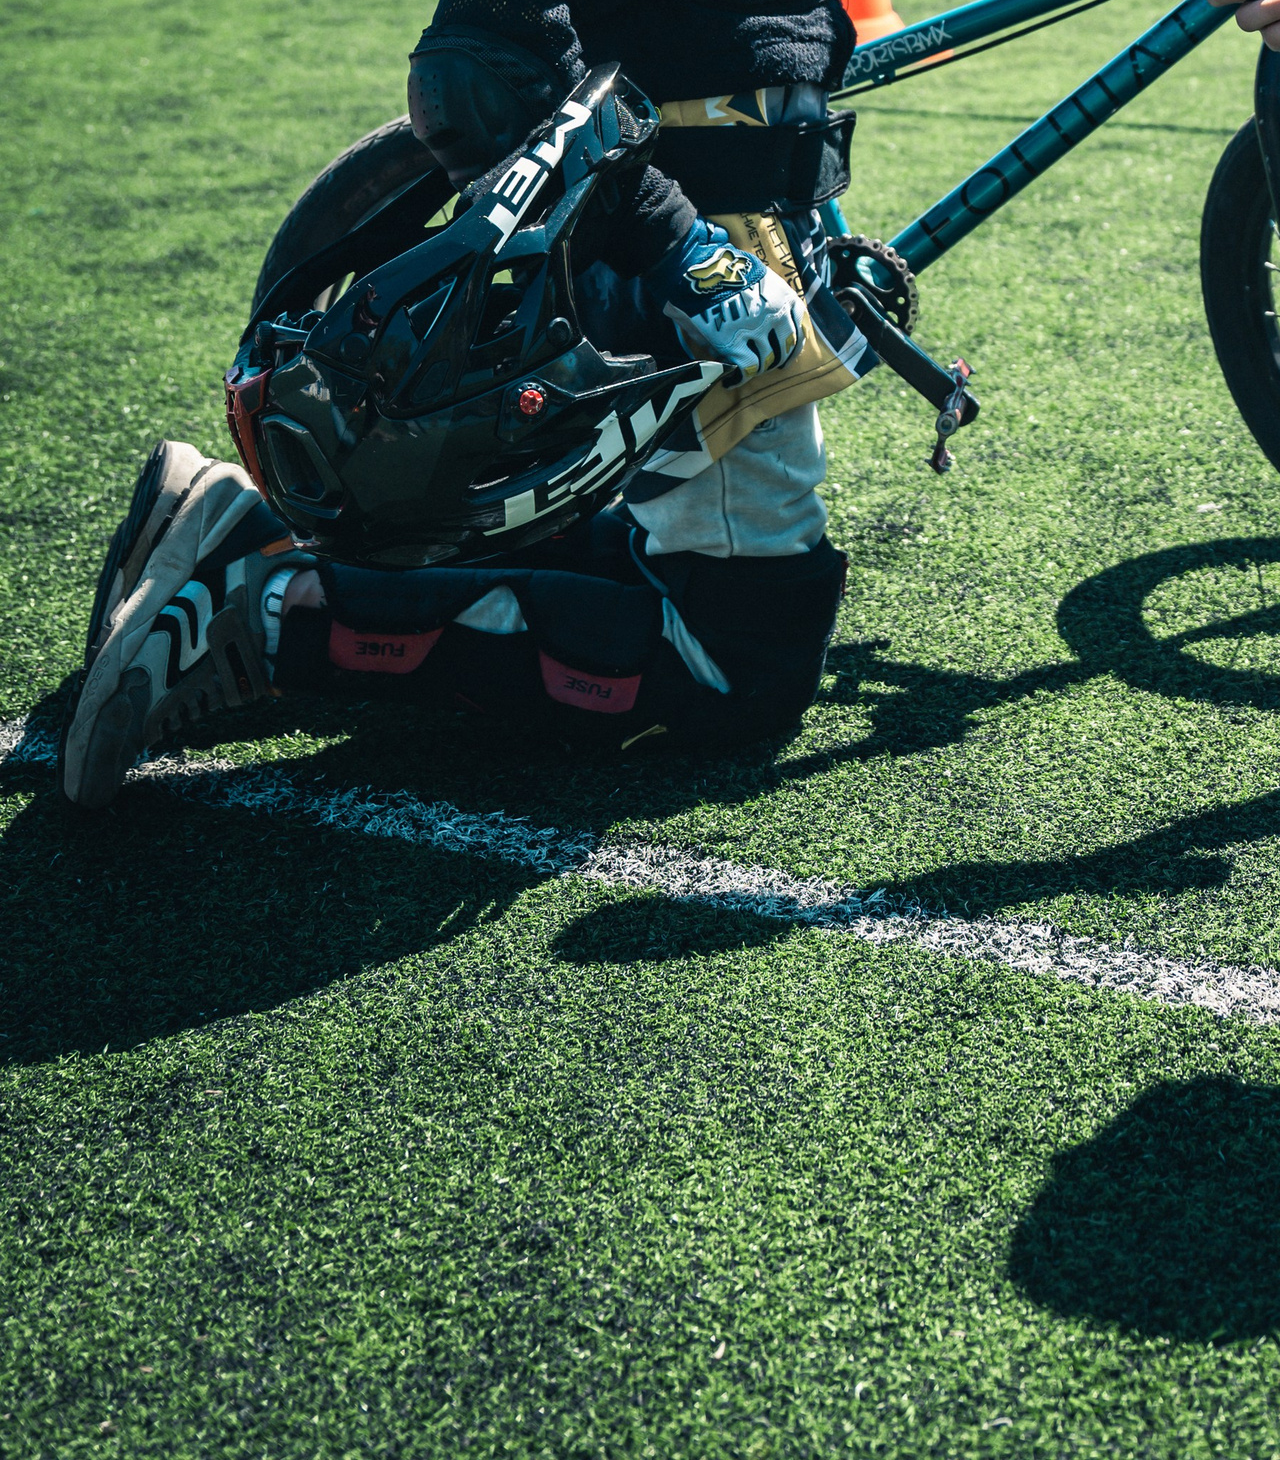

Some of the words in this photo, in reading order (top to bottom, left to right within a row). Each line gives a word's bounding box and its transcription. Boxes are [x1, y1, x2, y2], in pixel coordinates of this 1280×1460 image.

[487, 100, 593, 255] MET
[741, 212, 760, 241] НИЕ
[753, 240, 770, 267] ТЕХ
[483, 361, 725, 537] MET
[355, 641, 405, 657] FUSE
[563, 675, 614, 700] FUSE
